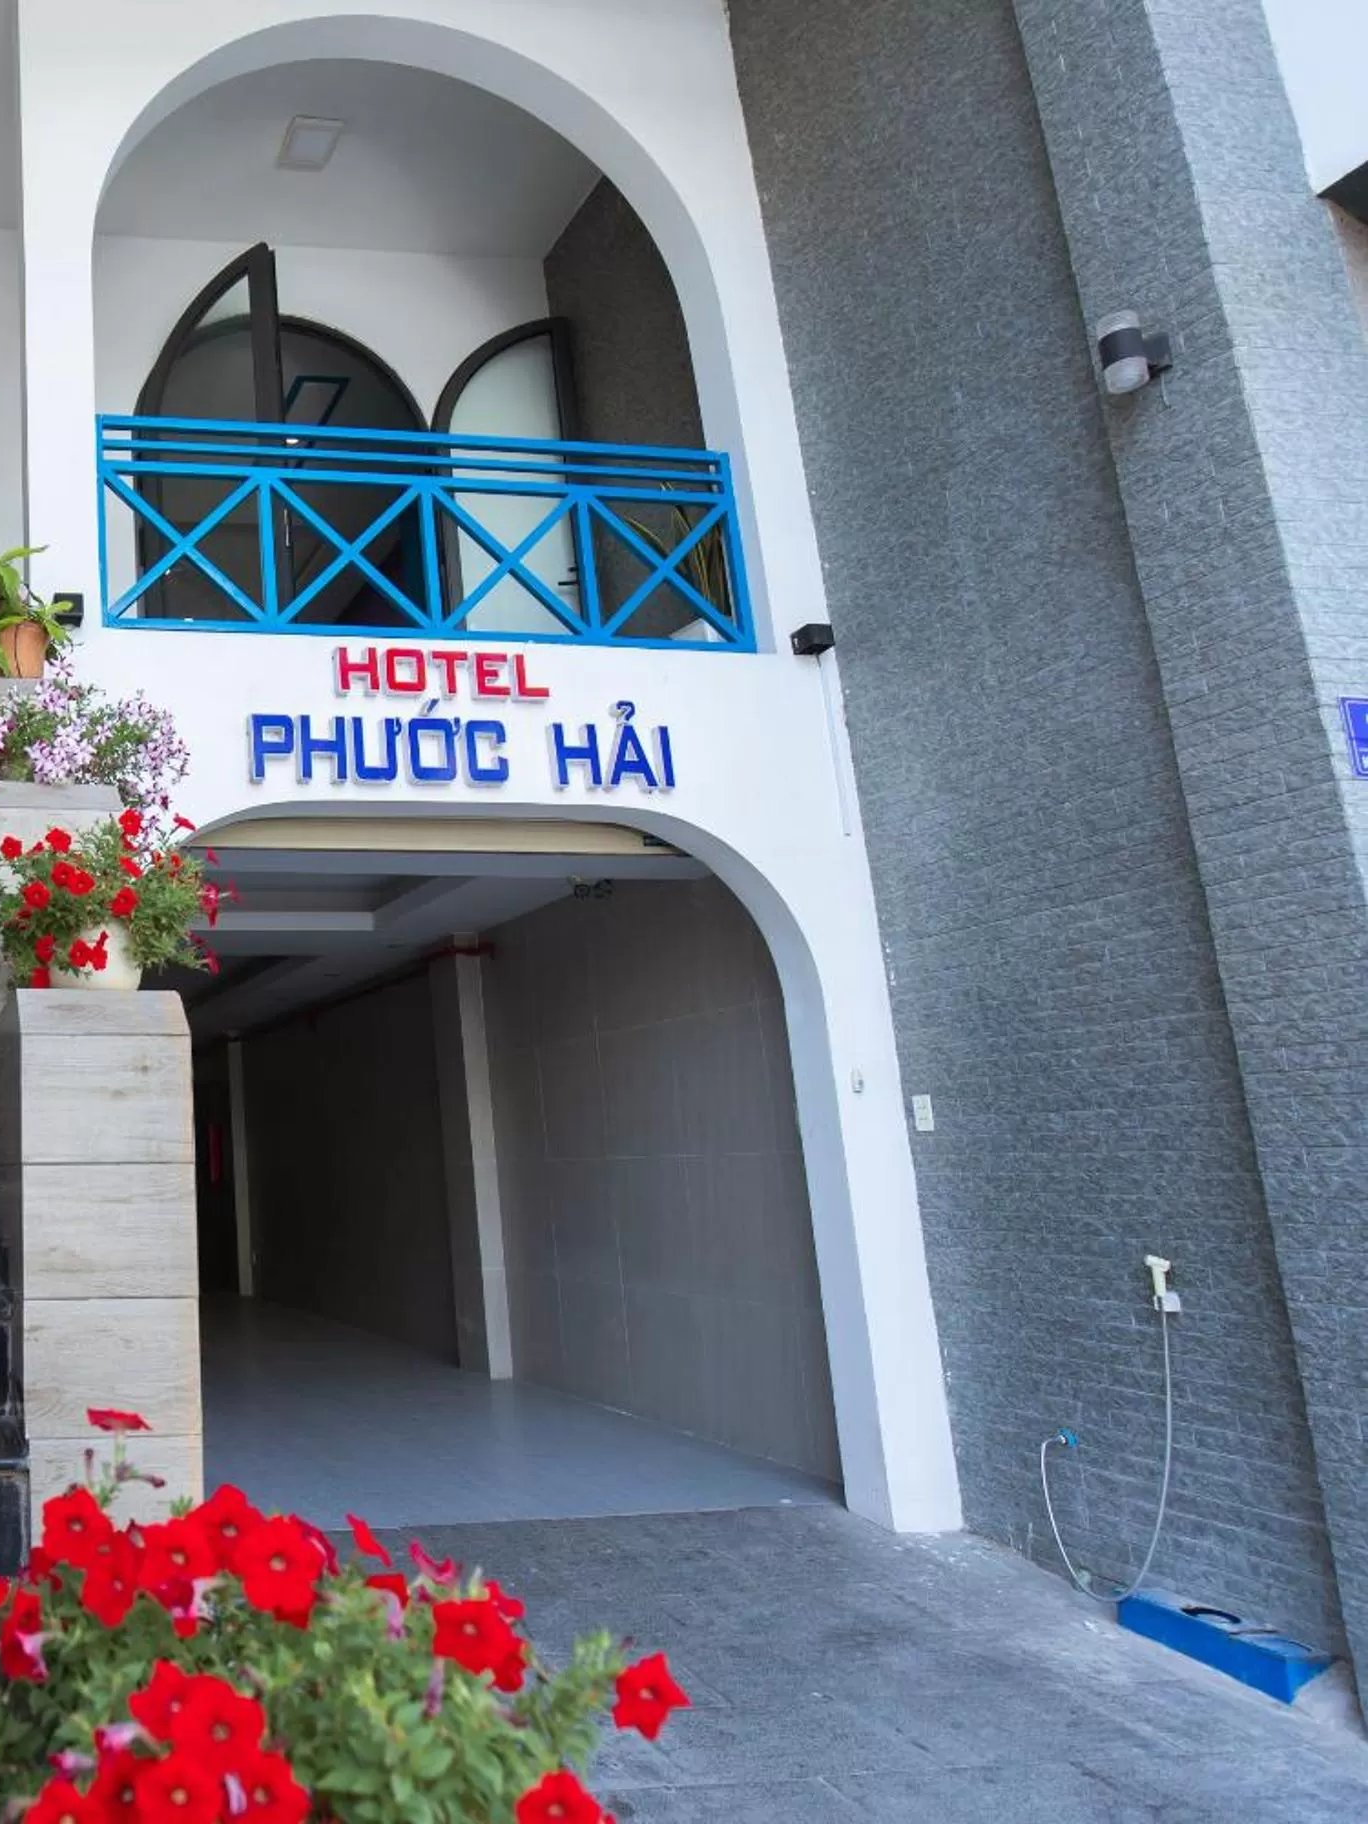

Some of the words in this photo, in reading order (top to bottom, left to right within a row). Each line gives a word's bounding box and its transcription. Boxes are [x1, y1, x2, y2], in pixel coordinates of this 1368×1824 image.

[337, 647, 550, 698] HOTEL
[250, 699, 509, 783] PHƯỚC
[549, 701, 676, 789] HẢI
